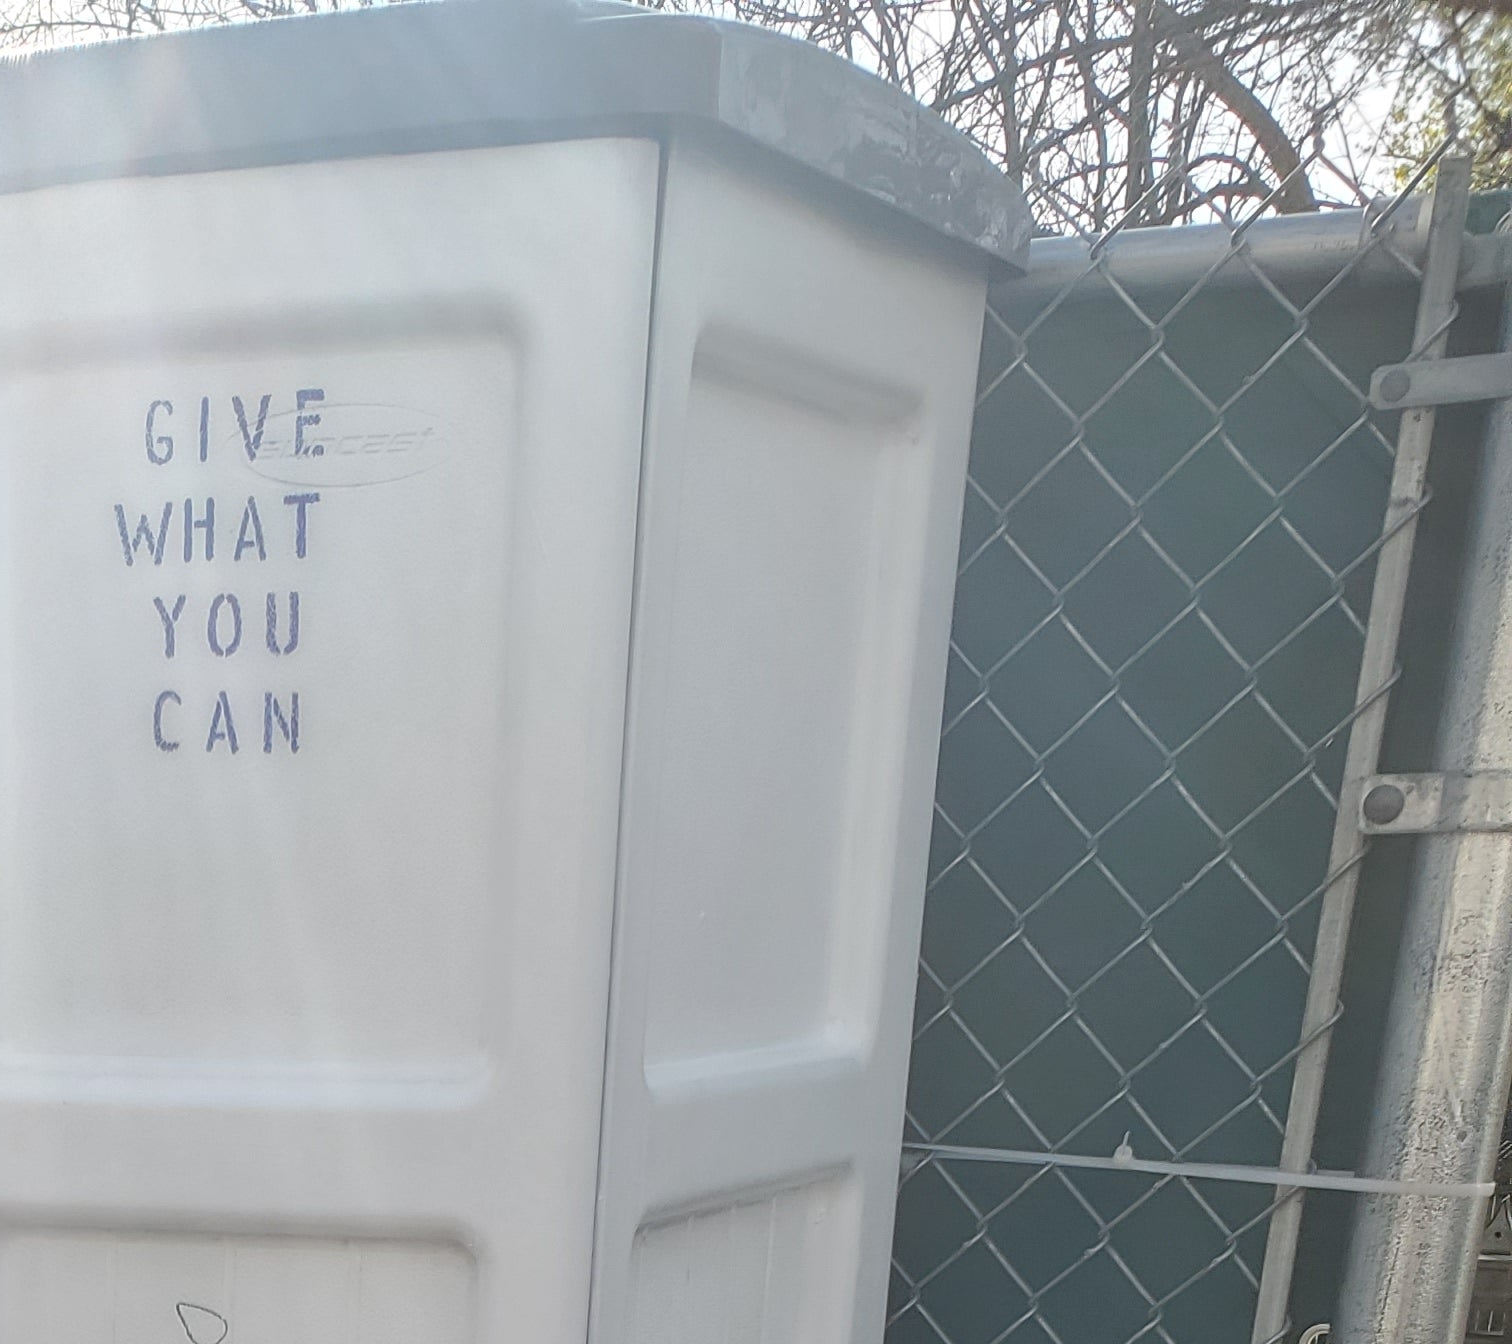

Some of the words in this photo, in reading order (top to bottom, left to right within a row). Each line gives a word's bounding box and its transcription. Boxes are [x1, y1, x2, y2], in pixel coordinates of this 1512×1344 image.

[145, 388, 325, 465] GIVE
[114, 493, 320, 566] WHAT
[153, 592, 299, 659] YOU
[153, 690, 300, 754] CAN
